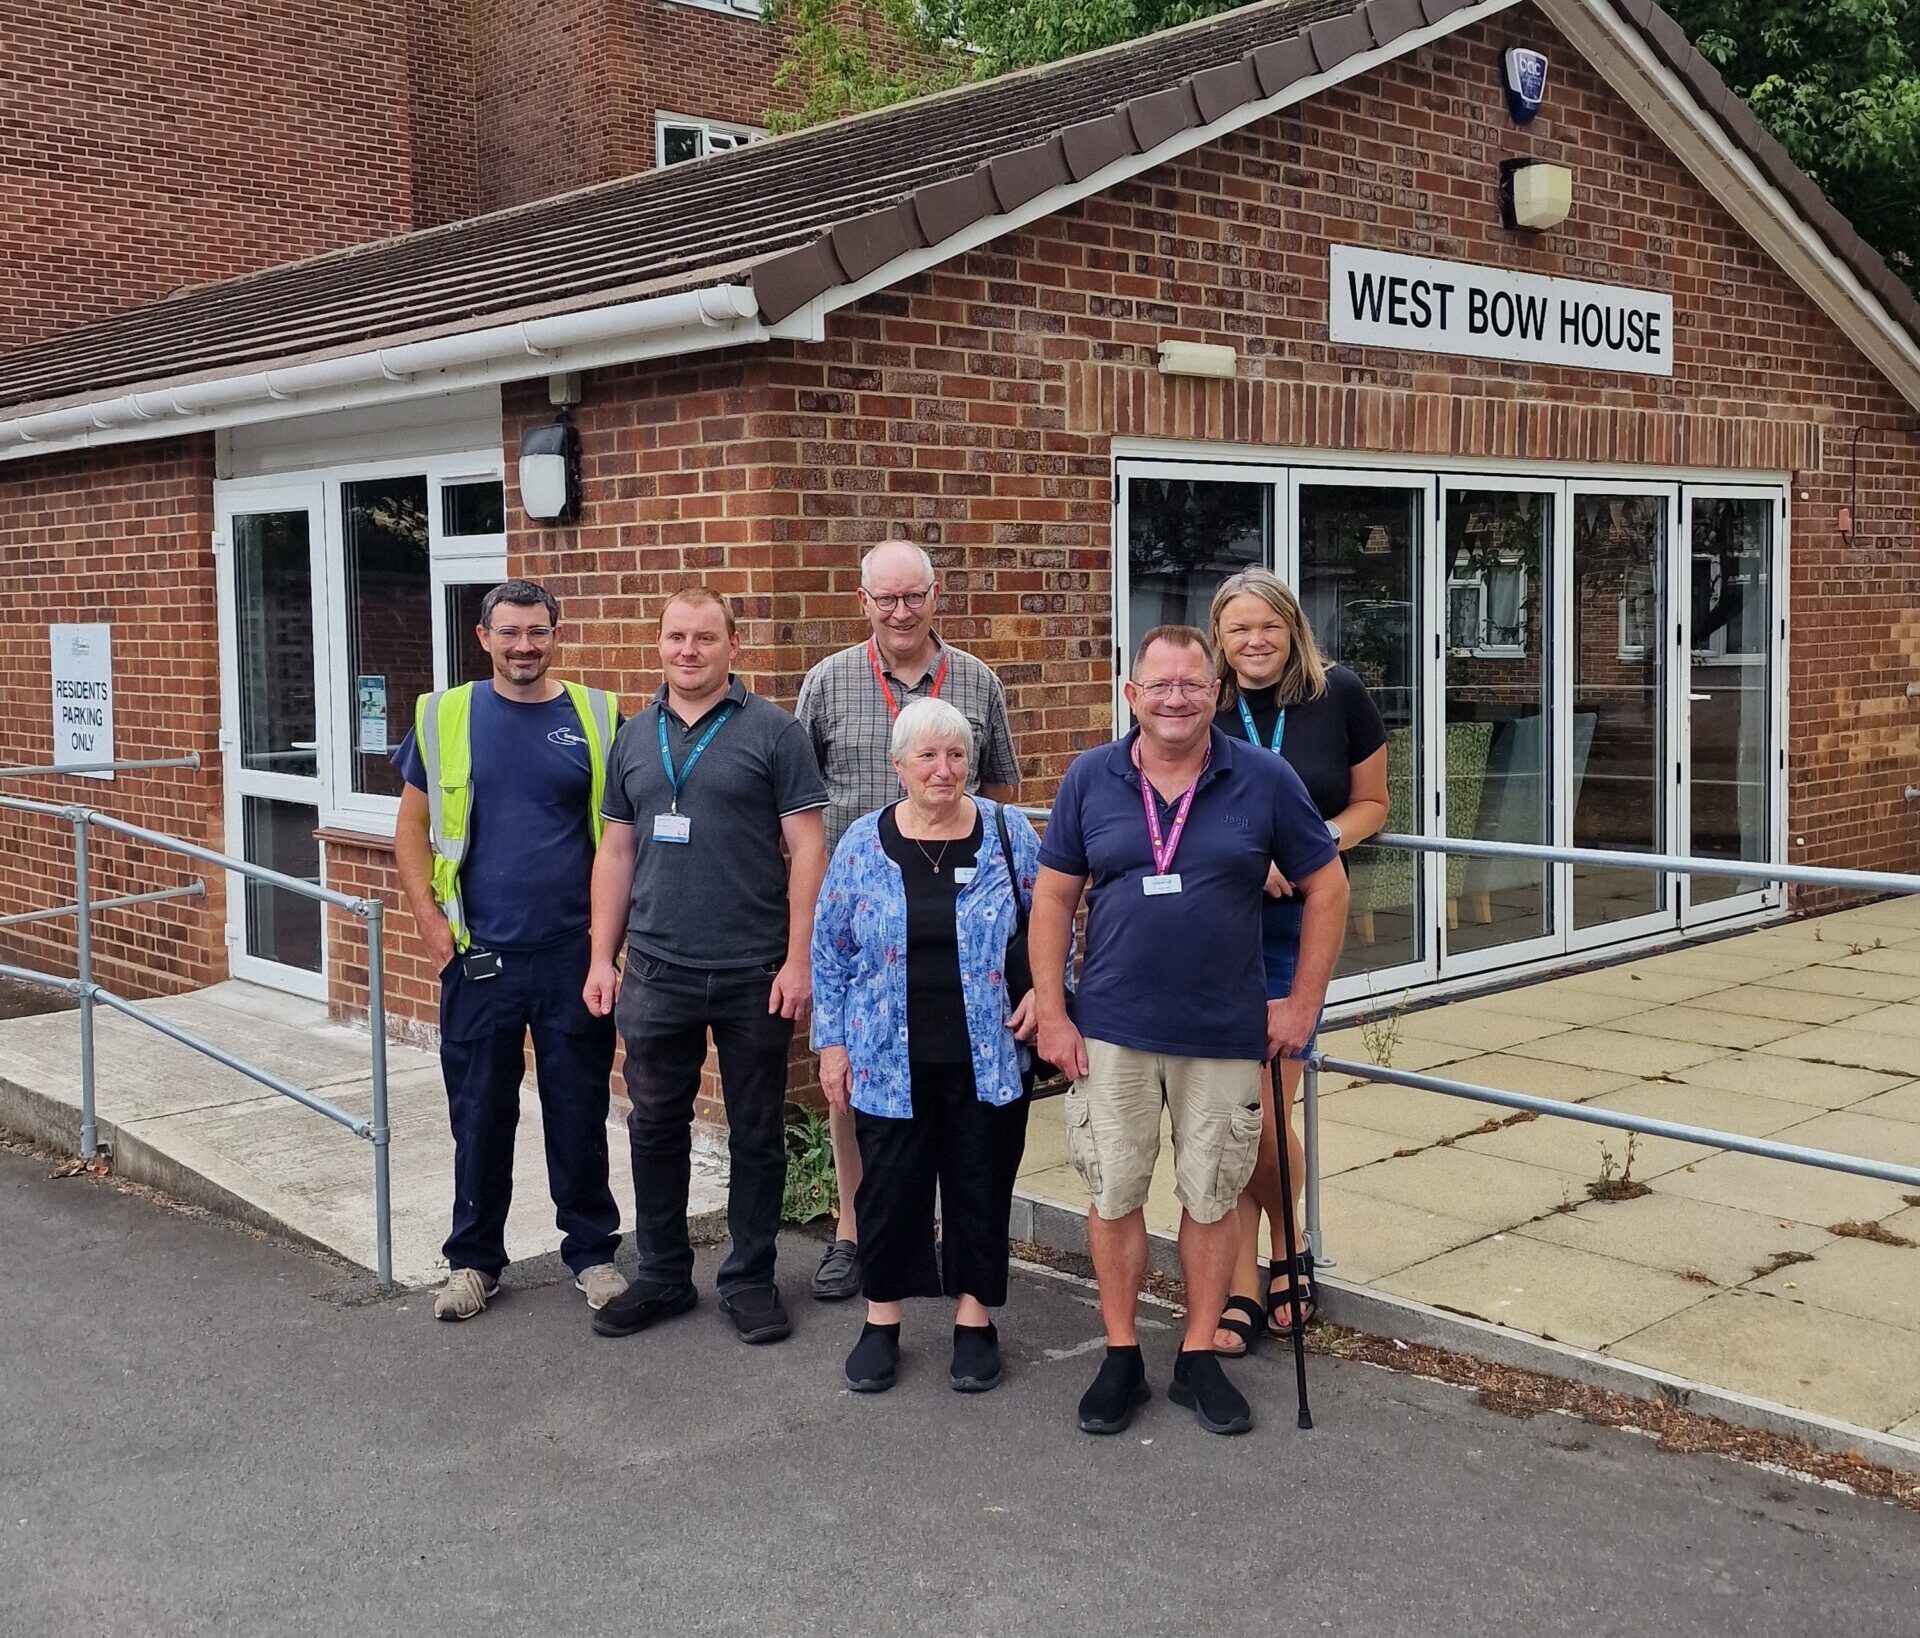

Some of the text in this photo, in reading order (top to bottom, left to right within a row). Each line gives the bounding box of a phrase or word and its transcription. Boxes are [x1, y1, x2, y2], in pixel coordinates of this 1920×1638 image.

[1348, 271, 1661, 355] WEST BOW HOUSE
[56, 680, 108, 701] RESIDENTS
[62, 706, 103, 727] PARKING
[71, 732, 95, 752] ONLY
